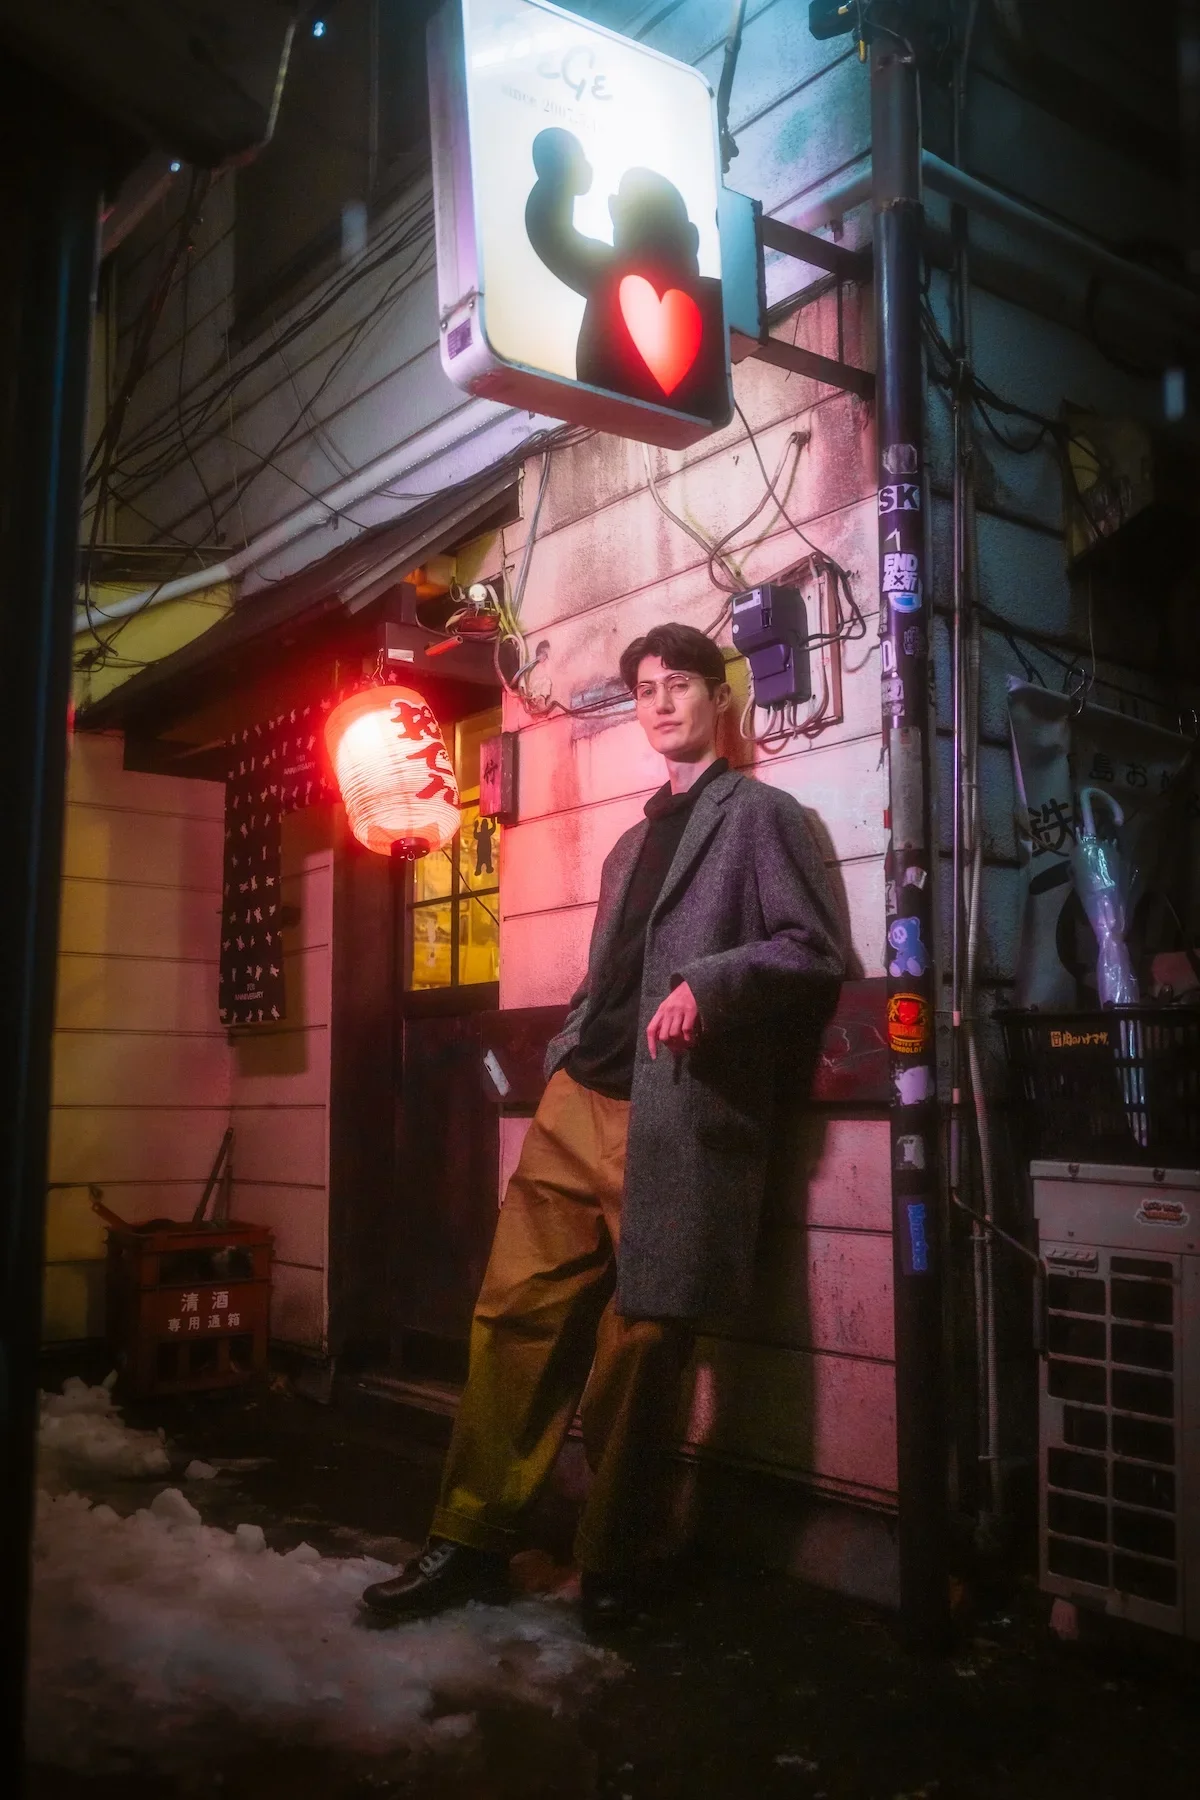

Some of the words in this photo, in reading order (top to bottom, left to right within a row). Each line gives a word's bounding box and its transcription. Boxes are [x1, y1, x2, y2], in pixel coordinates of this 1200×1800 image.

[879, 485, 918, 512] SK
[884, 553, 919, 573] END
[181, 1291, 230, 1312] 清酒
